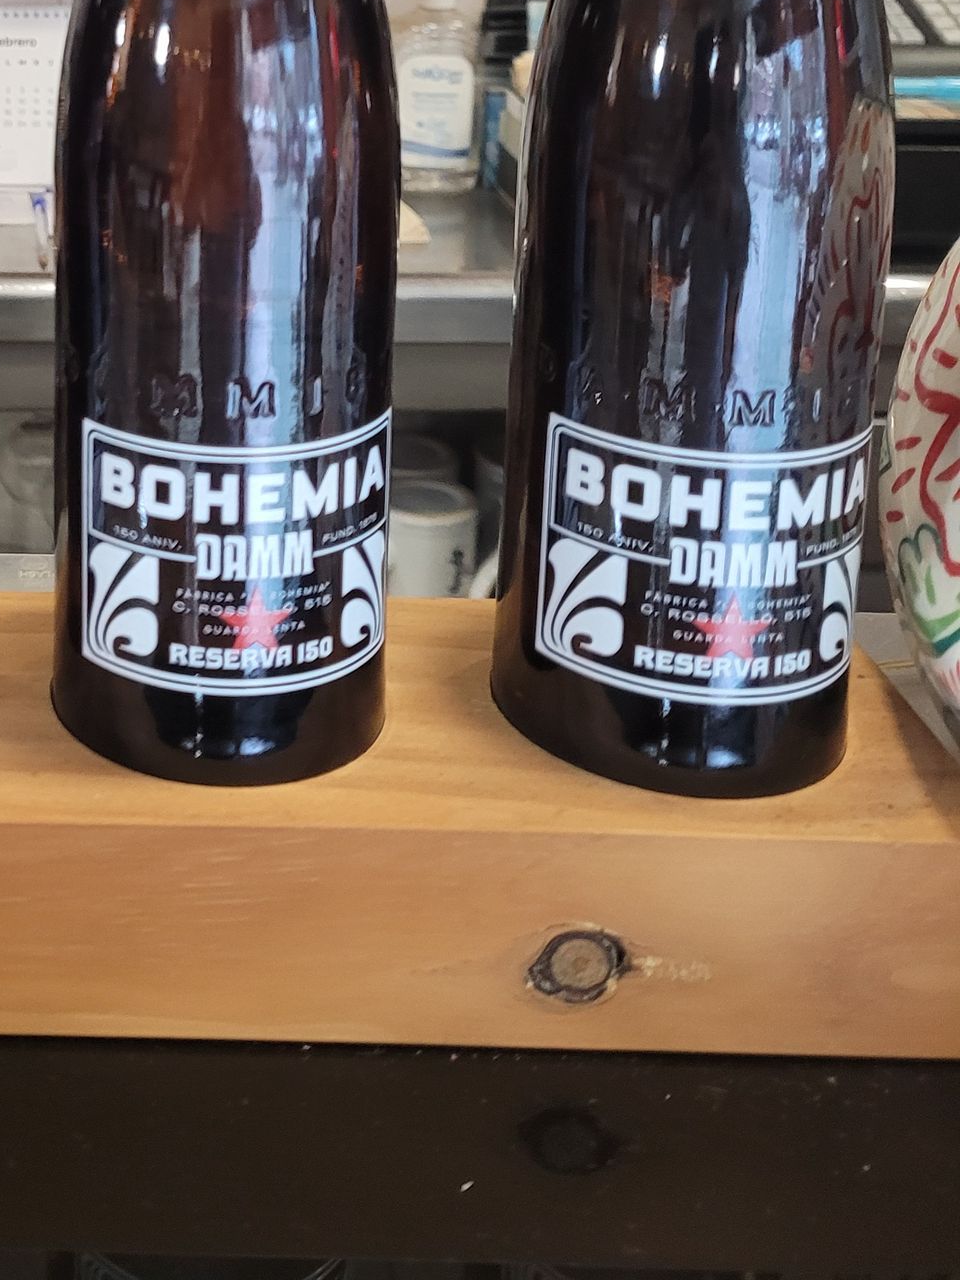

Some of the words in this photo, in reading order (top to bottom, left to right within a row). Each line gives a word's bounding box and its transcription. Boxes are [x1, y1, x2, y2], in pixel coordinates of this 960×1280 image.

[100, 444, 385, 525] BOHEMIA
[565, 447, 866, 531] BOHEMIA
[195, 528, 315, 581] DAMM
[669, 536, 798, 588] DAMM
[168, 641, 293, 670] RESERVA
[296, 635, 334, 665] 150
[633, 645, 771, 679] RESERVA
[774, 649, 812, 677] 150
